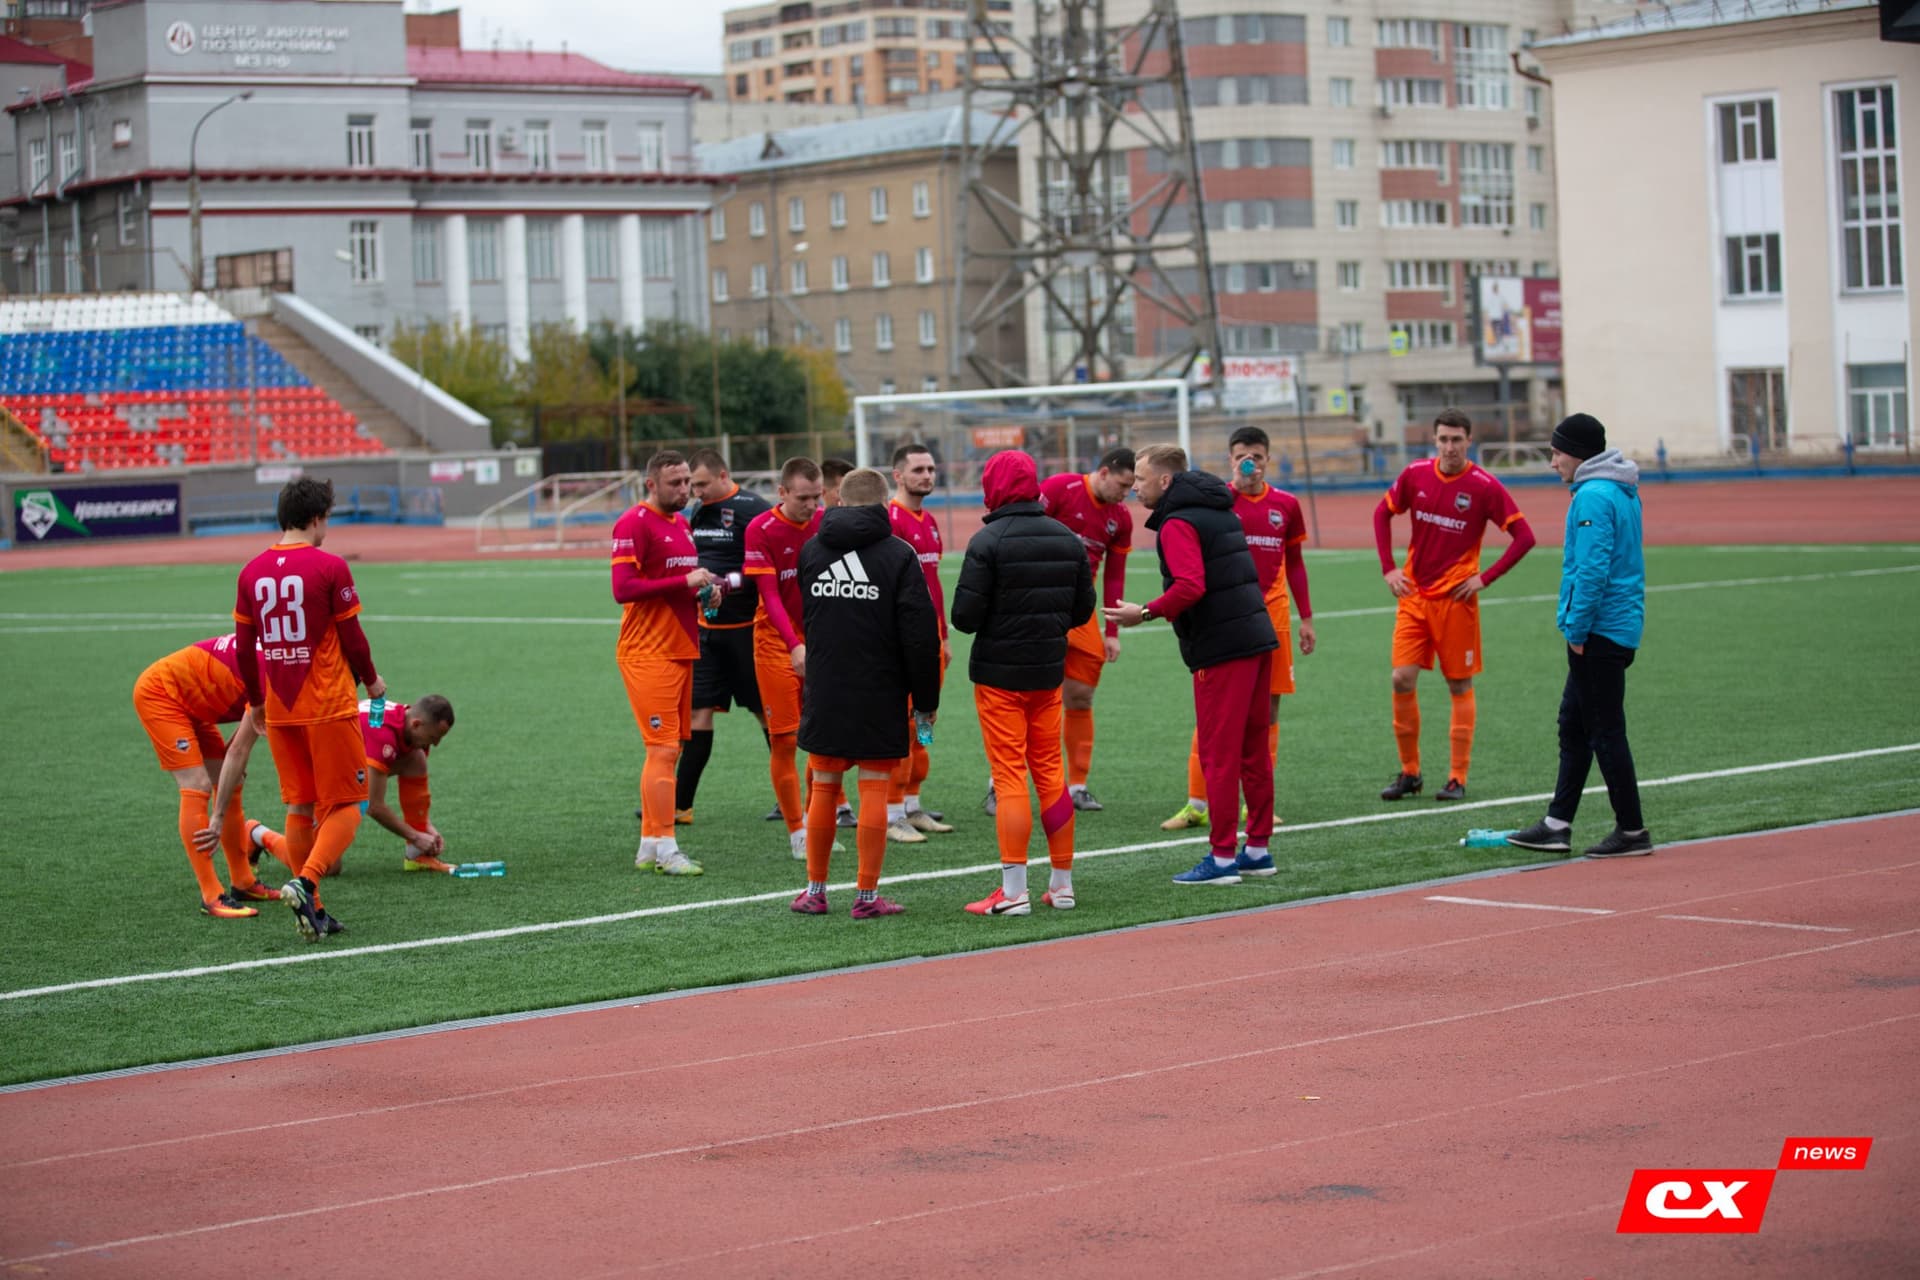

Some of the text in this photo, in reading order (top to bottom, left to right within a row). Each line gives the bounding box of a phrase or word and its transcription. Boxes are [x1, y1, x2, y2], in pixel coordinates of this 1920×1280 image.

[811, 580, 880, 600] adidas
[255, 575, 306, 643] 23
[265, 646, 309, 660] SEUS
